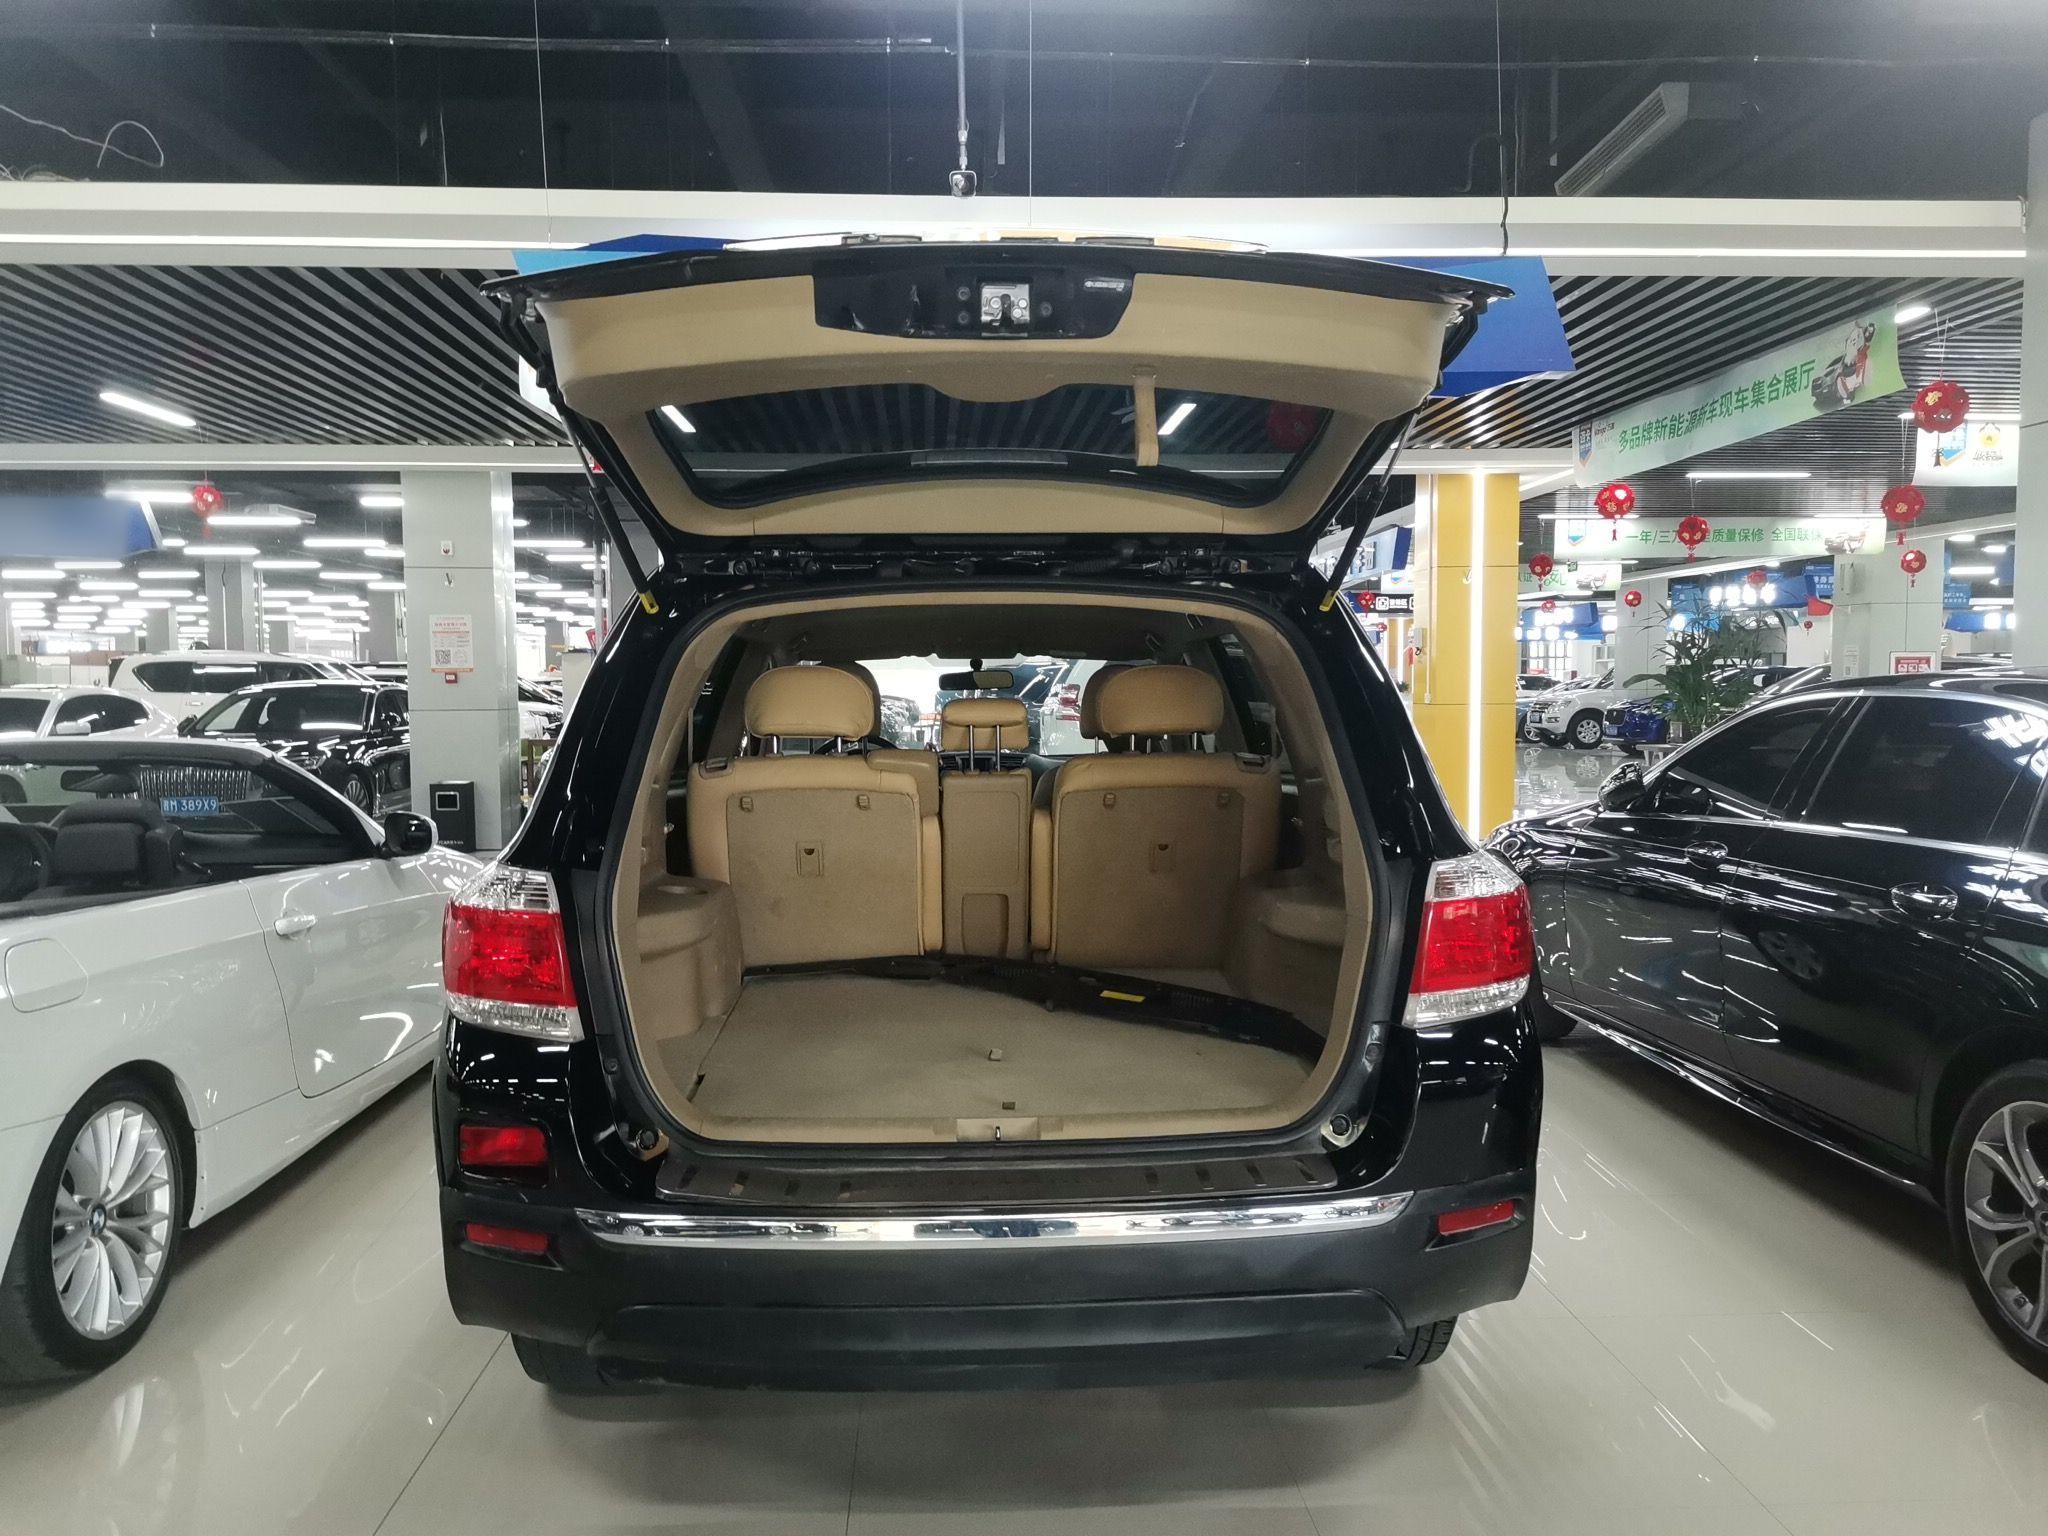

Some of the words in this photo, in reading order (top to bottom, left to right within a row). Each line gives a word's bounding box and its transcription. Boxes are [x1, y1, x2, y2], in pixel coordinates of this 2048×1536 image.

[1618, 359, 1816, 454] 多品牌新能源新车现车集合展厅
[1625, 528, 1764, 544] 一年/三万质量保修
